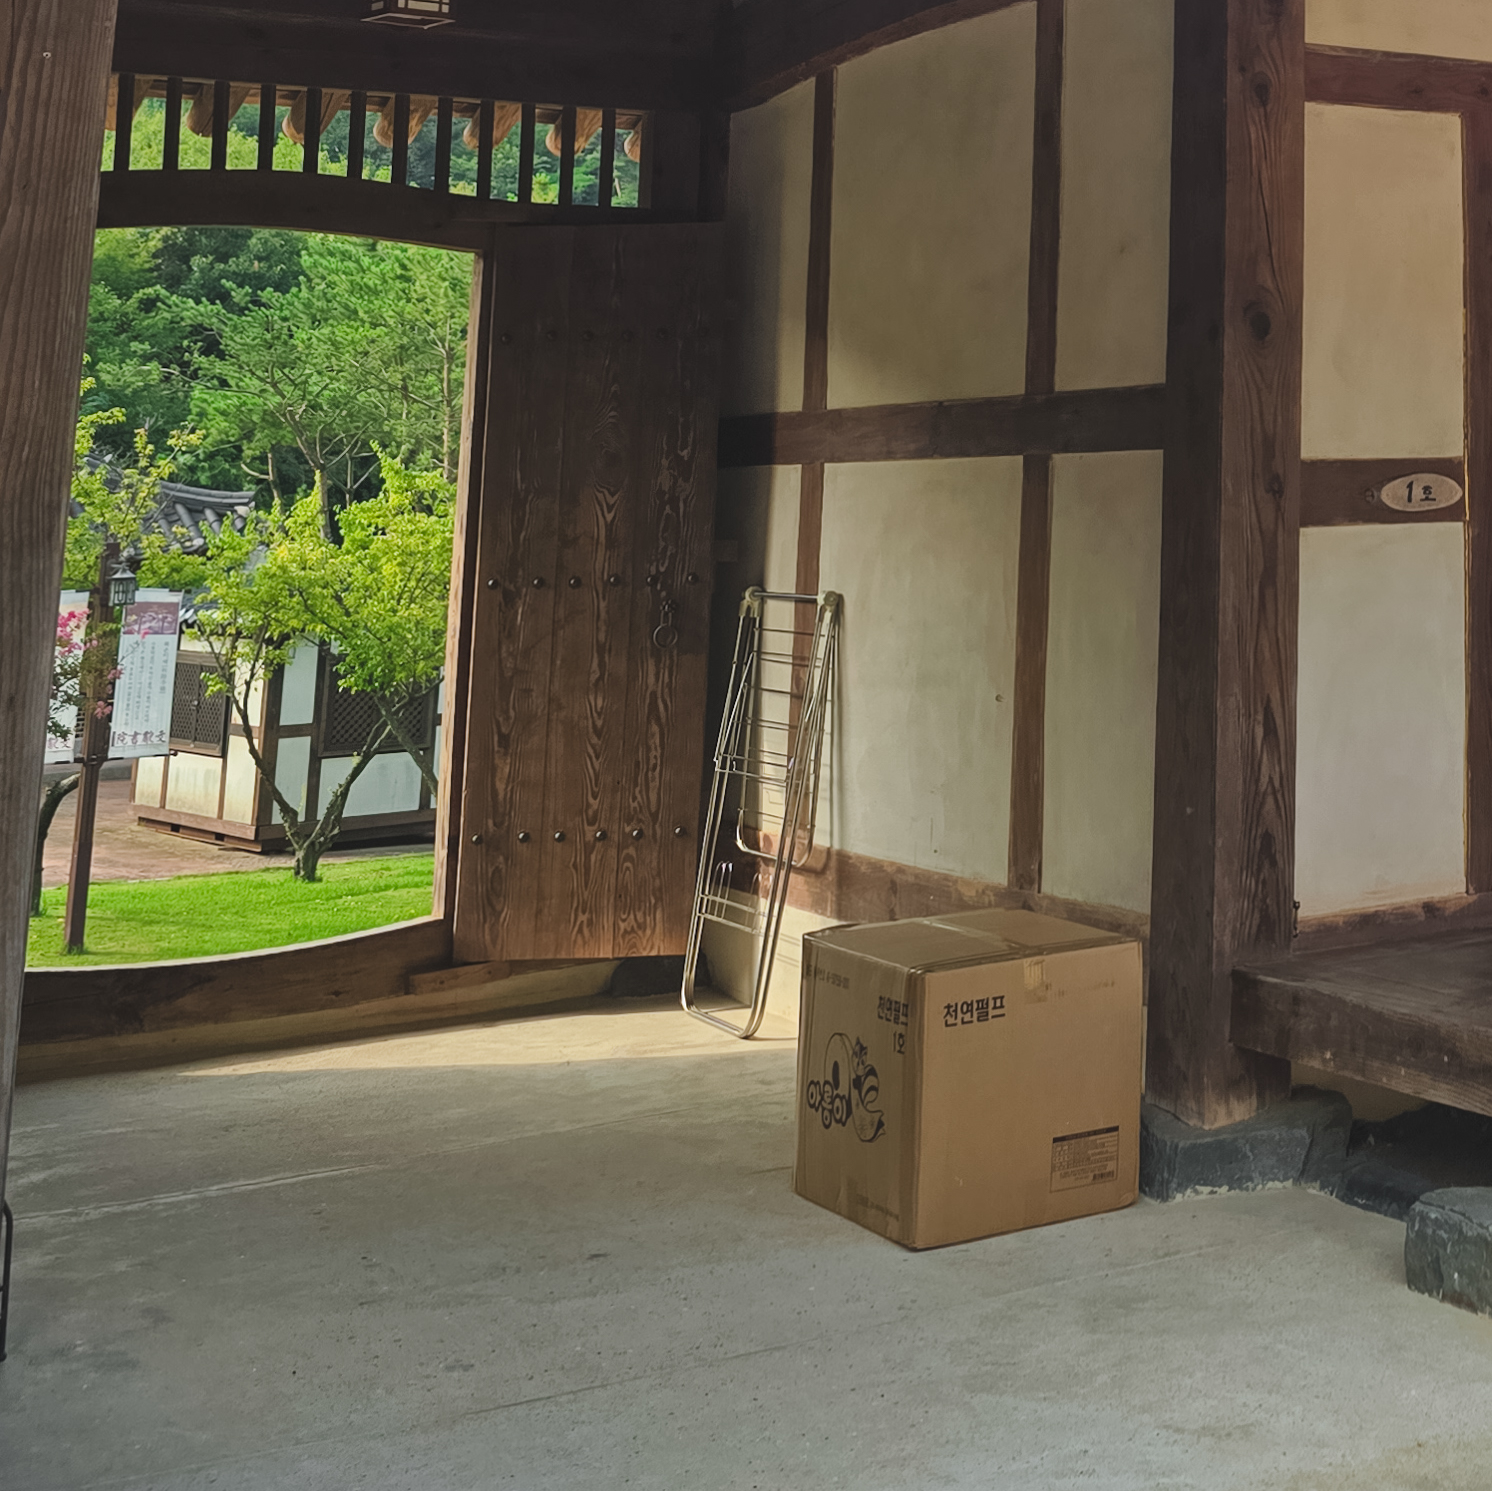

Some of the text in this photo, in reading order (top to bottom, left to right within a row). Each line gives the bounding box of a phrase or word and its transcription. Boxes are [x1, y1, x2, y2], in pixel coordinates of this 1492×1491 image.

[1406, 480, 1437, 503] 1호
[877, 995, 910, 1027] 천연펄프
[942, 995, 1006, 1028] 천연펄프
[892, 1030, 906, 1055] 1호
